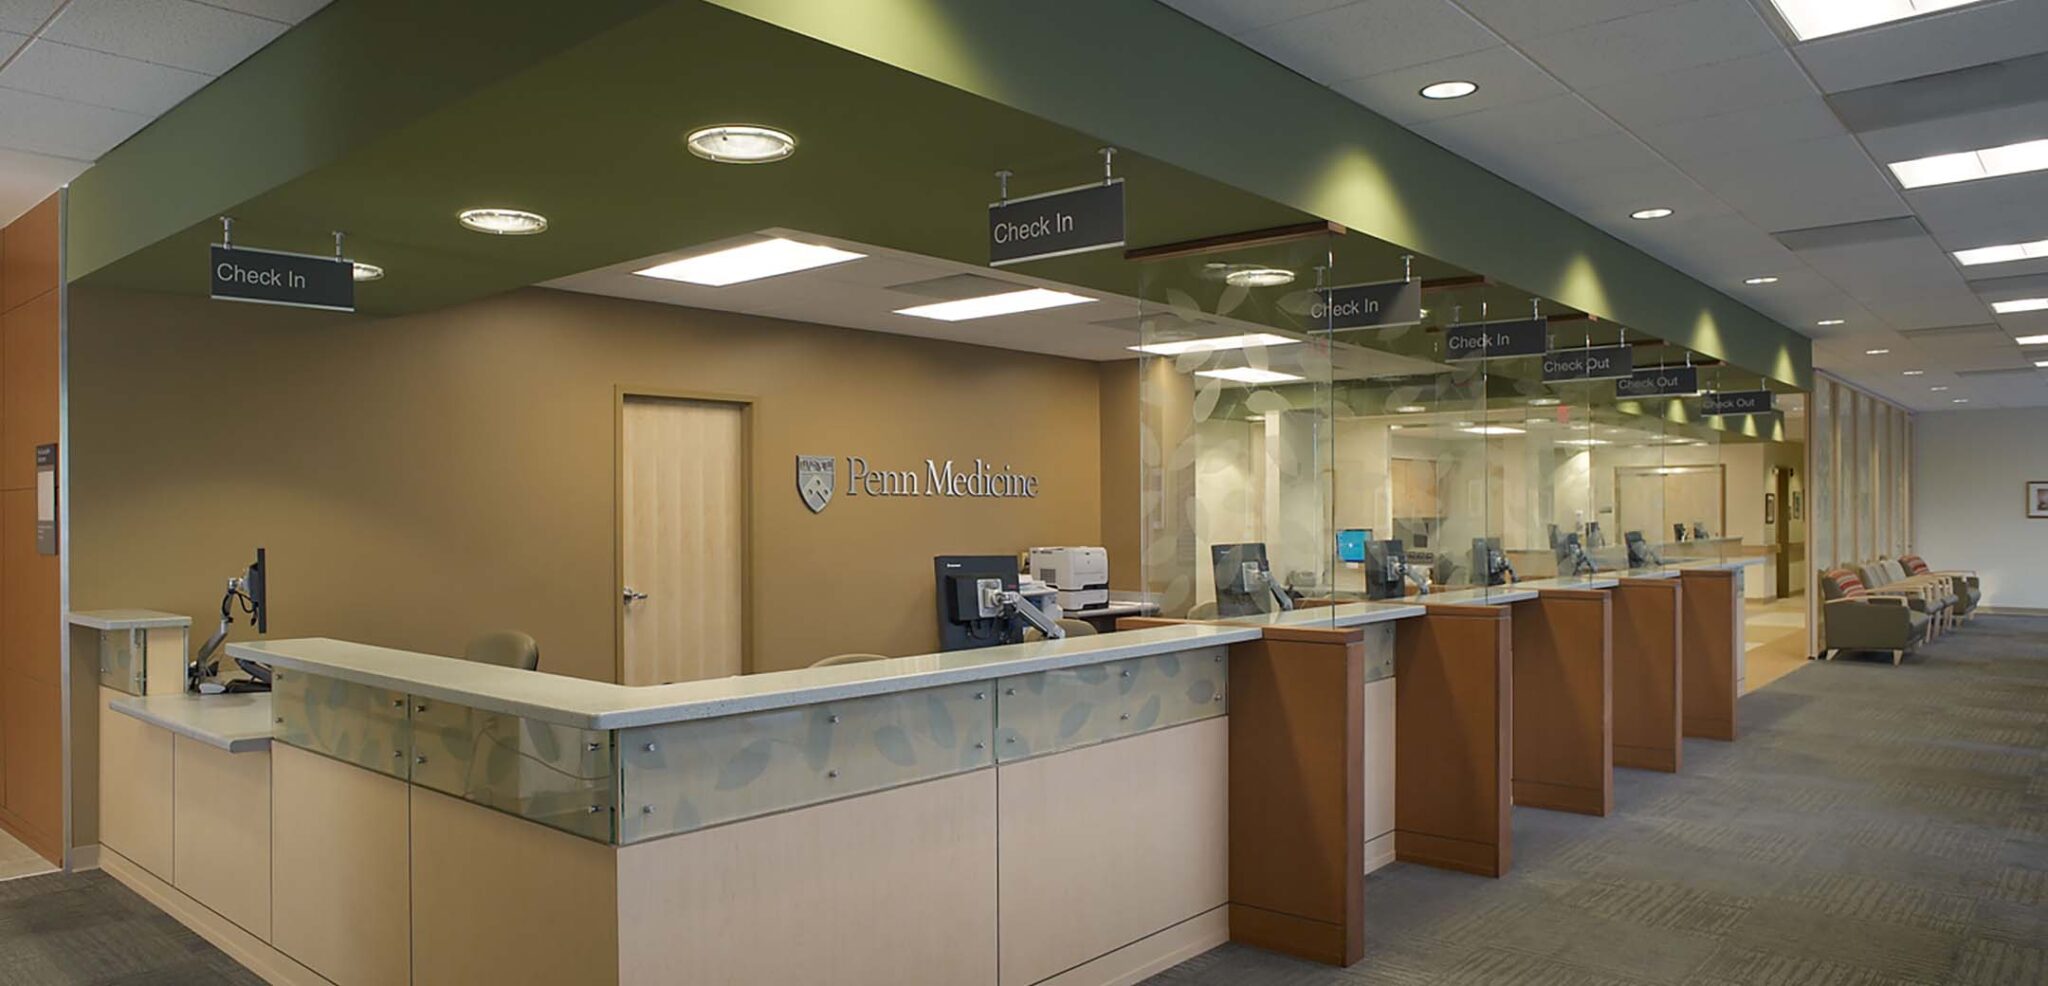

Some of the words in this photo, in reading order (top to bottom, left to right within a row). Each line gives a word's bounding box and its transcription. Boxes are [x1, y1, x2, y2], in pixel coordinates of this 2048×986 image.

[995, 216, 1051, 243] Check
[1056, 212, 1073, 233] In
[217, 263, 282, 286] Check
[289, 270, 305, 288] In
[1311, 300, 1360, 318] Check
[1364, 298, 1379, 313] In
[1448, 333, 1493, 349] Check
[1497, 333, 1510, 346] In
[1543, 360, 1583, 373] Check
[1657, 376, 1679, 387] Out
[847, 457, 918, 496] Penn
[923, 459, 1039, 498] Medicine
